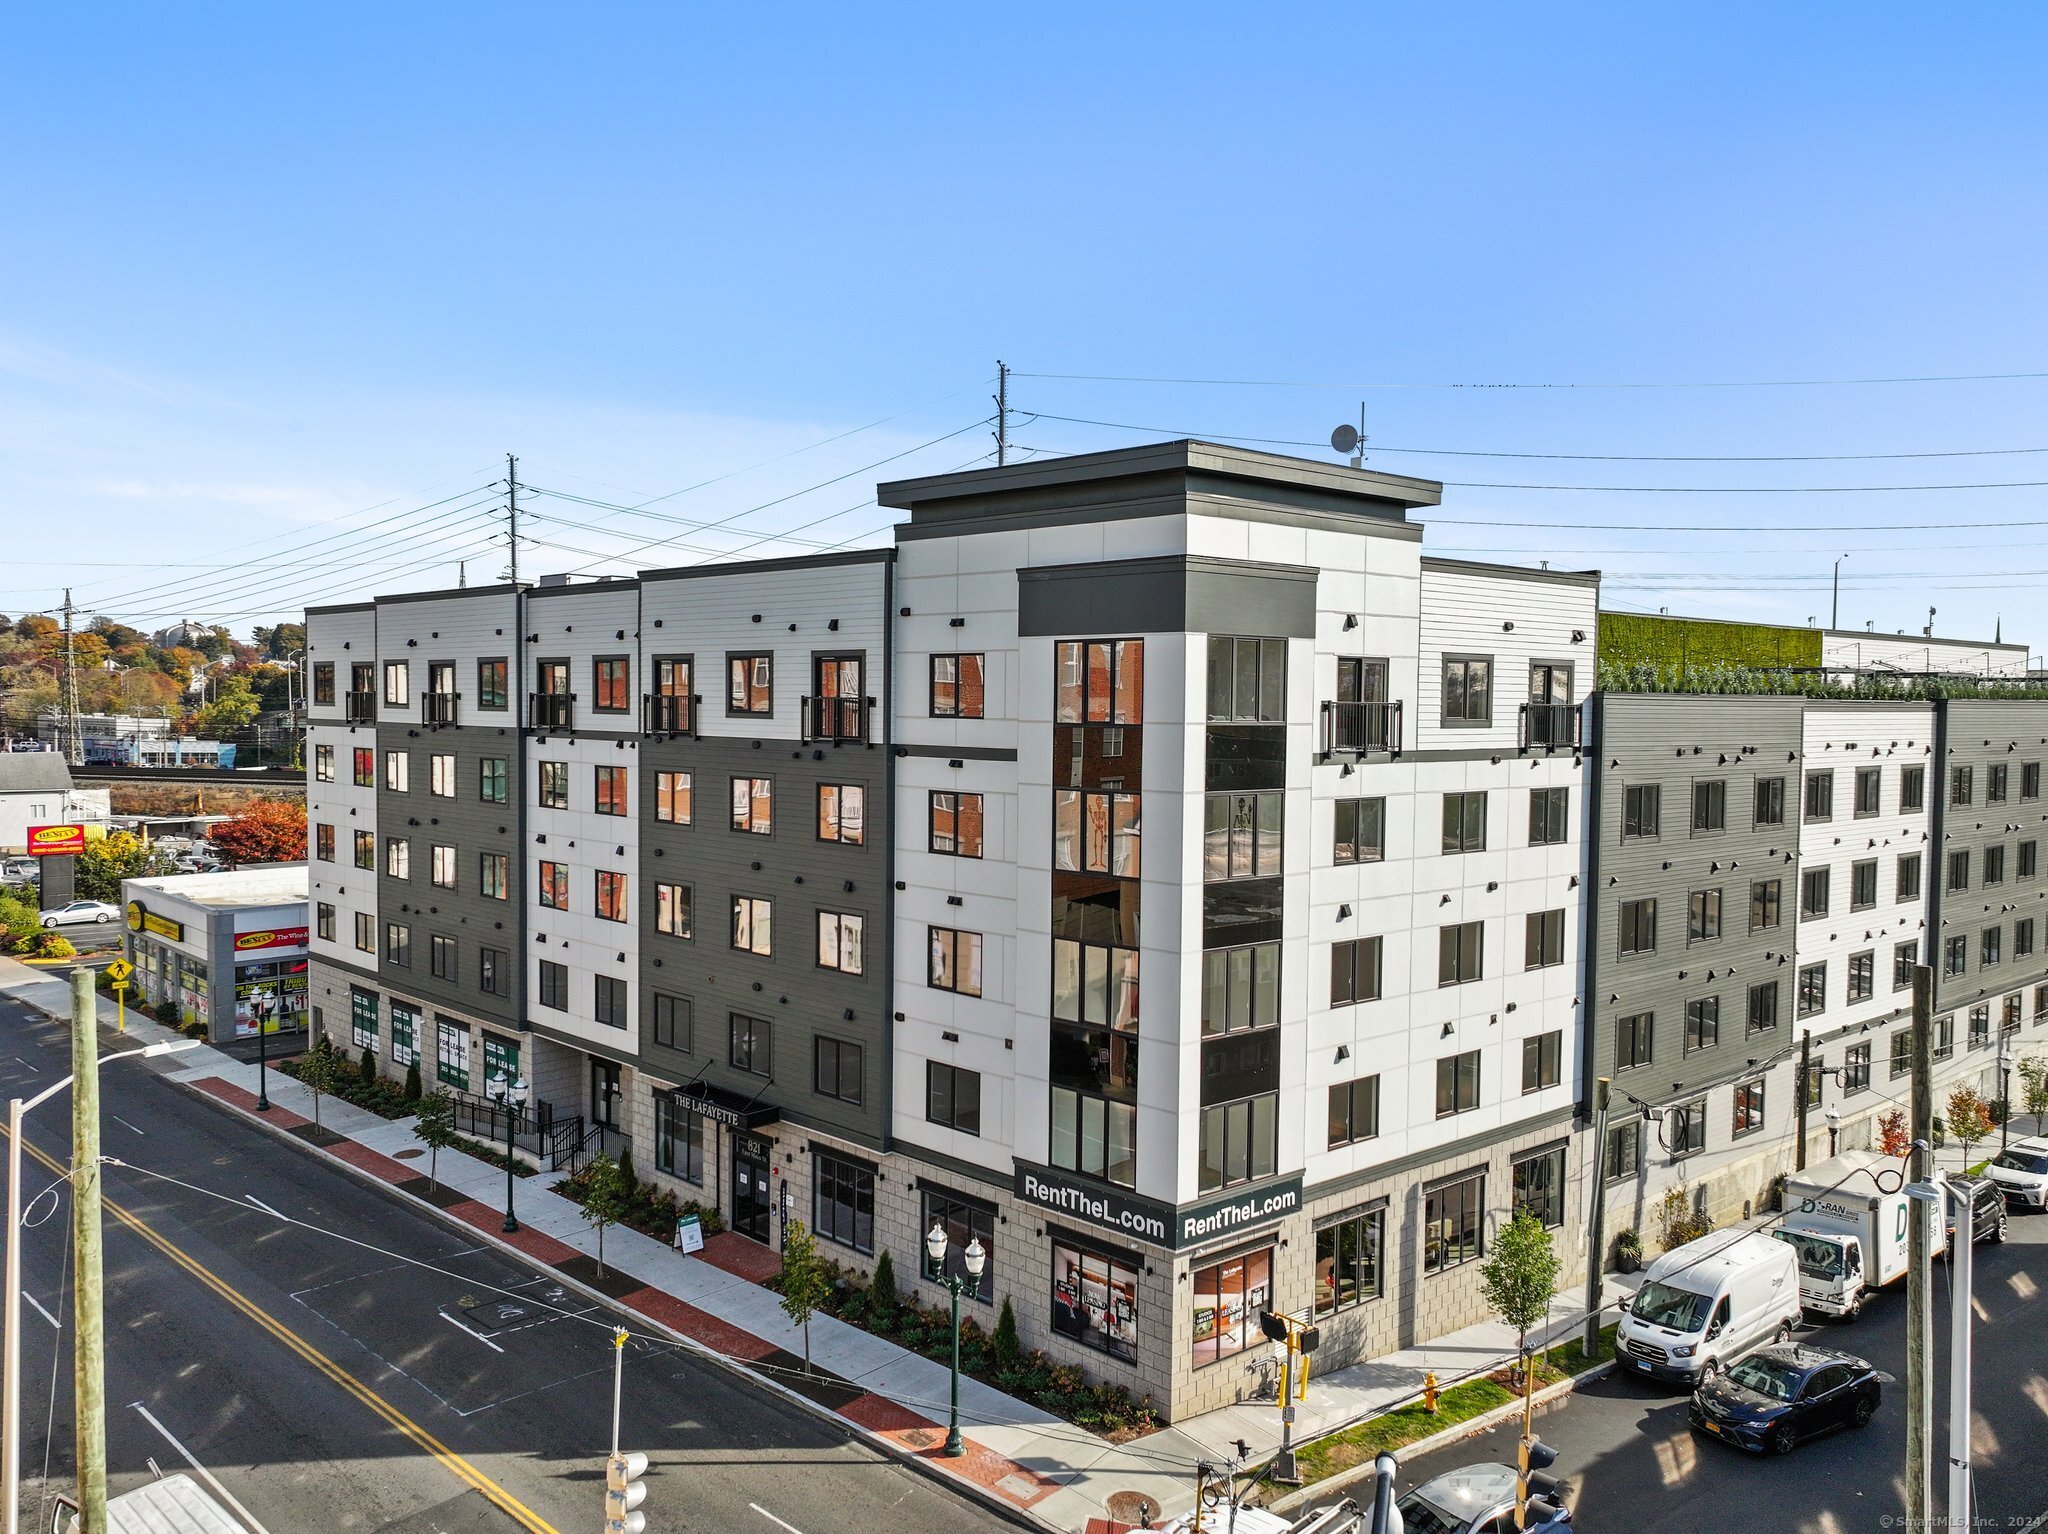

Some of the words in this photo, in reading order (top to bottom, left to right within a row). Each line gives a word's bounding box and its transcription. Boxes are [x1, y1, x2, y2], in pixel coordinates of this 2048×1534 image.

[354, 1006, 362, 1015] FOR
[363, 1010, 377, 1020] LEASE
[393, 1021, 402, 1030] FOR
[403, 1025, 418, 1036] LEASE
[439, 1038, 449, 1047] FOR
[450, 1042, 466, 1054] LEASE
[486, 1055, 497, 1065] FOR
[498, 1060, 516, 1073] LEASE
[674, 1094, 690, 1109] THE
[692, 1100, 739, 1126] LAFAYETTE
[747, 1139, 761, 1154] 821
[1024, 1175, 1165, 1240] RentTheL.com
[1184, 1190, 1296, 1240] RentTheL.com
[1084, 1295, 1106, 1309] LEASING
